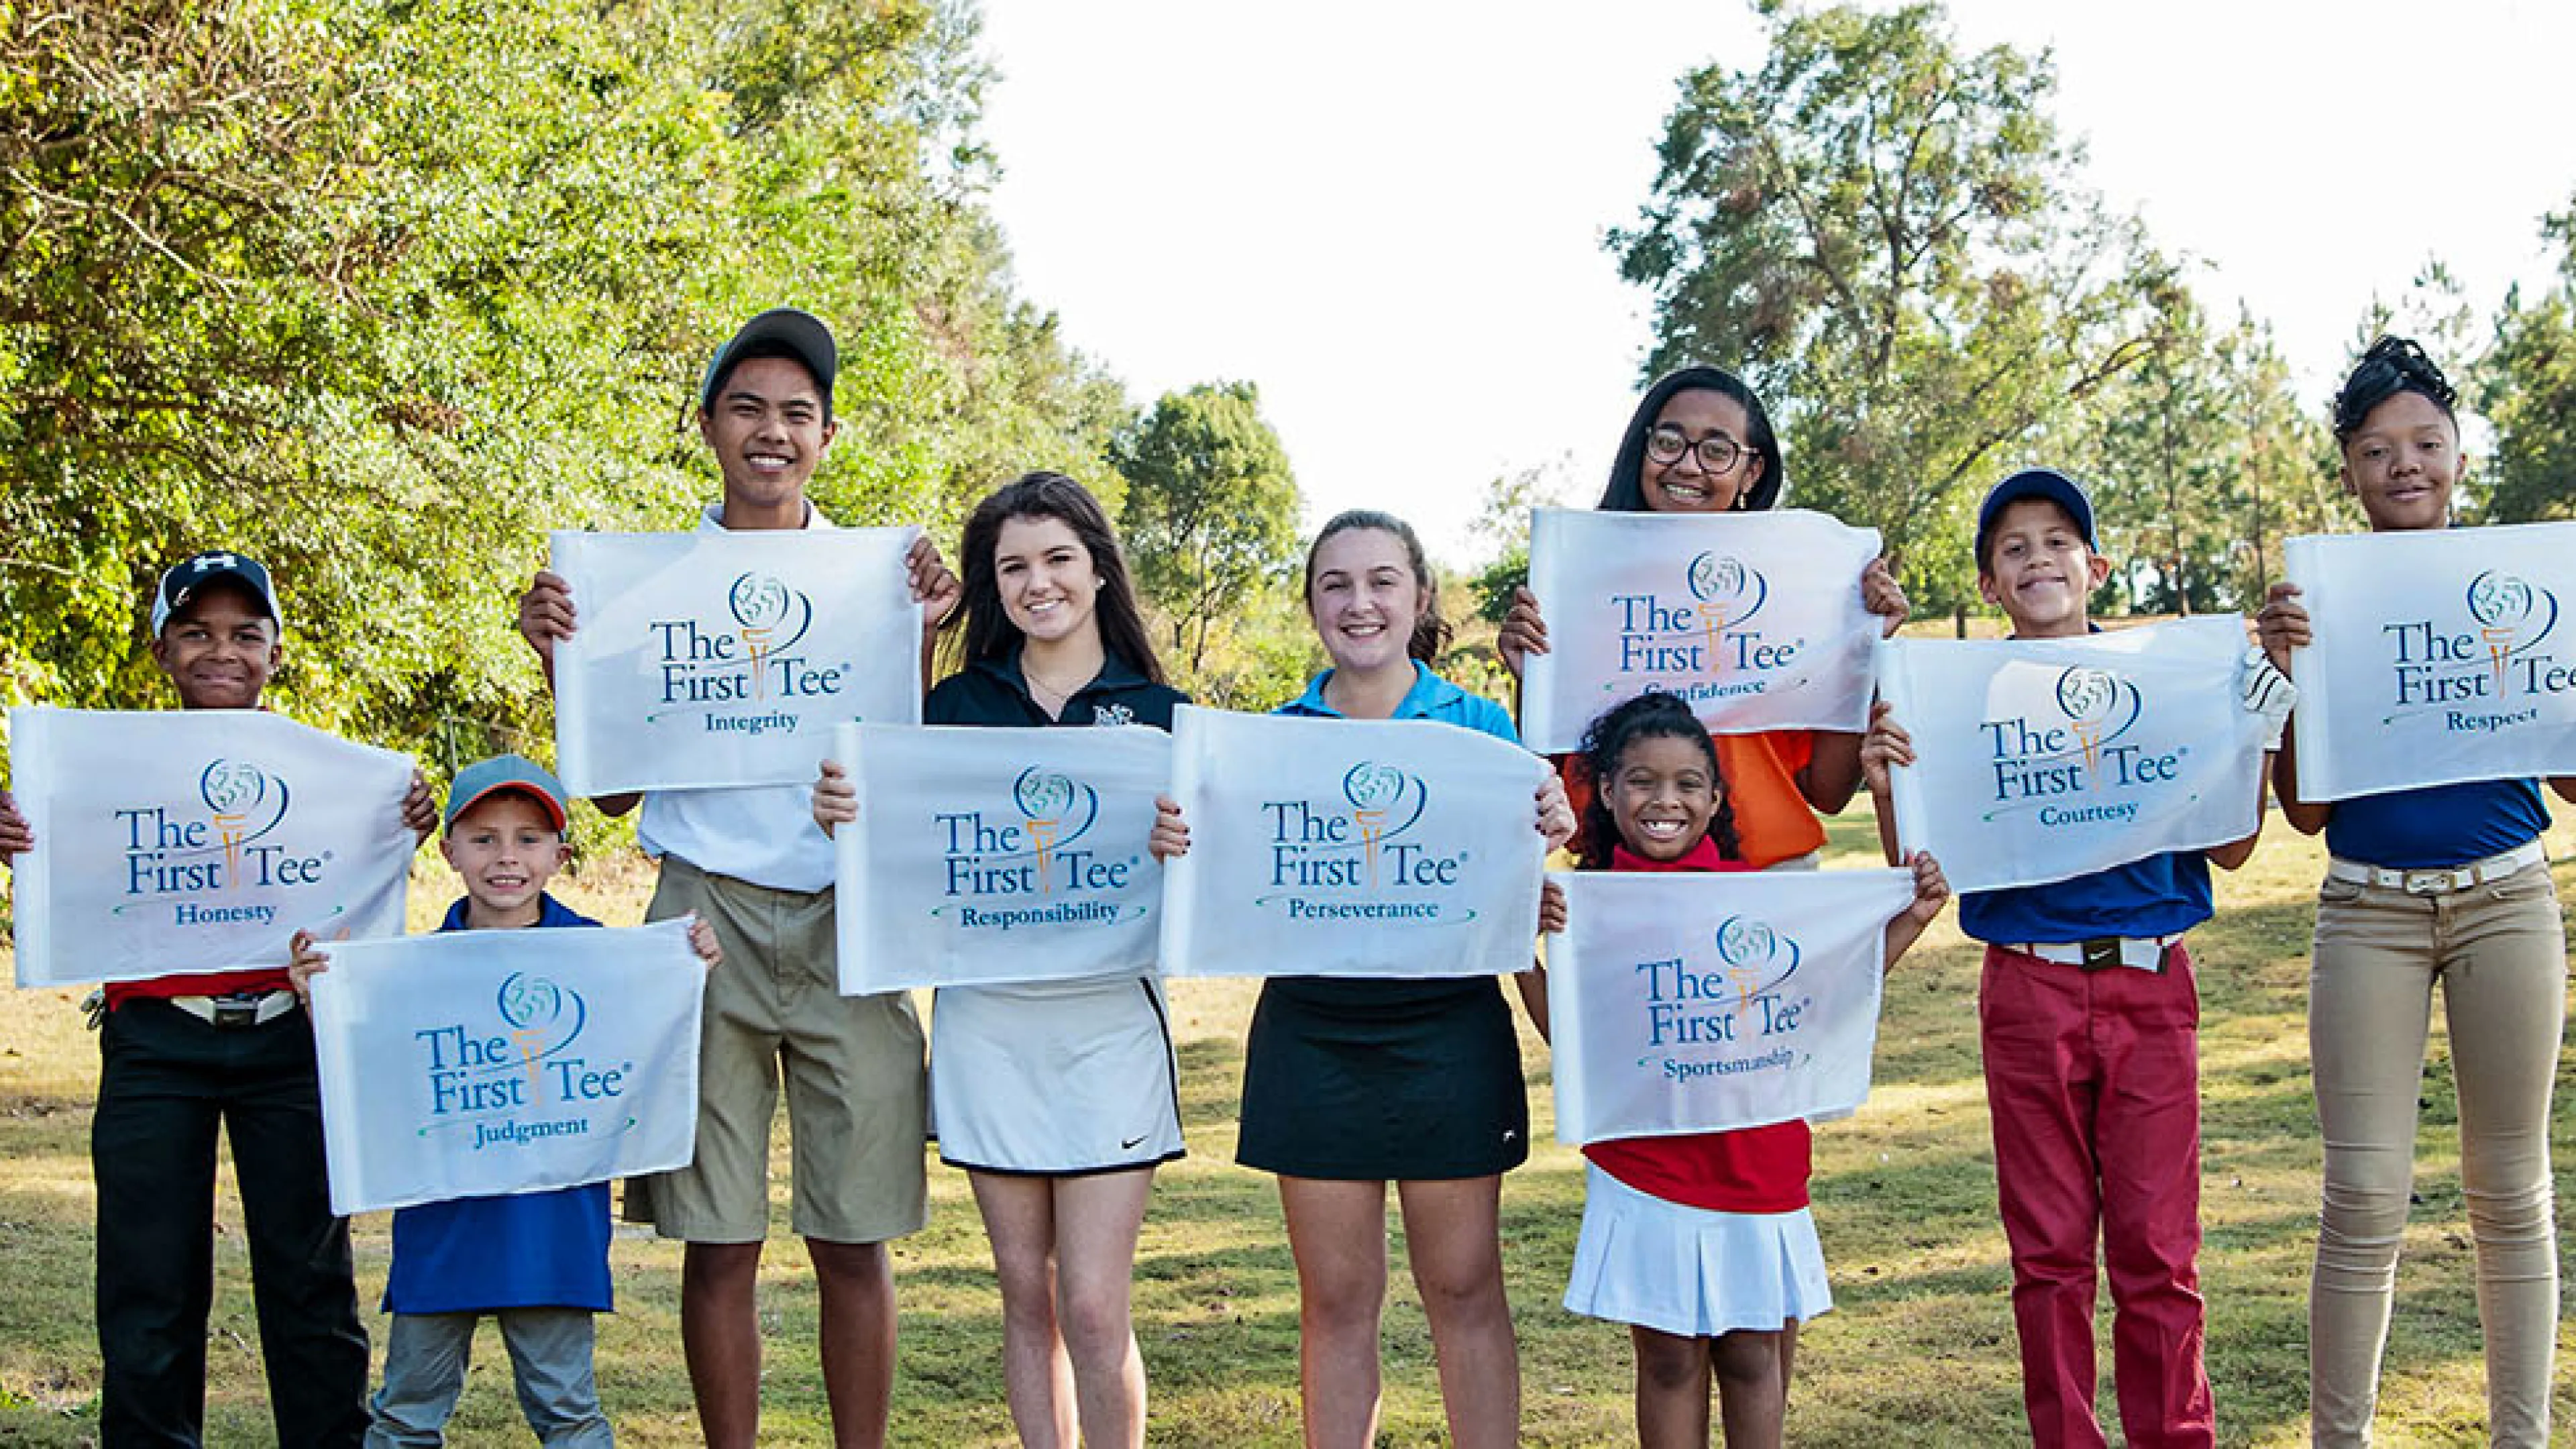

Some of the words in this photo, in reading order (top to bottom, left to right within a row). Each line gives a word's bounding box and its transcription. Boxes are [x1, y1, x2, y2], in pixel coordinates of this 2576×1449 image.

[1611, 594, 1691, 633] The
[649, 619, 735, 661] The
[1619, 634, 1705, 672] First
[2383, 621, 2475, 663] The
[661, 663, 749, 703] First
[2394, 665, 2489, 706] First
[706, 709, 798, 735] Integrity
[1980, 716, 2066, 758] The
[1993, 758, 2084, 802] First
[115, 806, 208, 849] The
[934, 811, 1020, 855] The
[1262, 800, 1349, 843] The
[2040, 803, 2140, 826] Courtesy
[125, 852, 222, 894] First
[945, 855, 1035, 896] First
[1271, 845, 1361, 886] First
[175, 903, 277, 925] Honesty
[961, 900, 1120, 930] Responsibility
[1289, 898, 1440, 919] Perseverance
[1635, 957, 1725, 1002] The
[1648, 1003, 1736, 1046] First
[415, 1024, 508, 1071] The
[429, 1070, 529, 1115] First
[474, 1118, 589, 1149] Judgment
